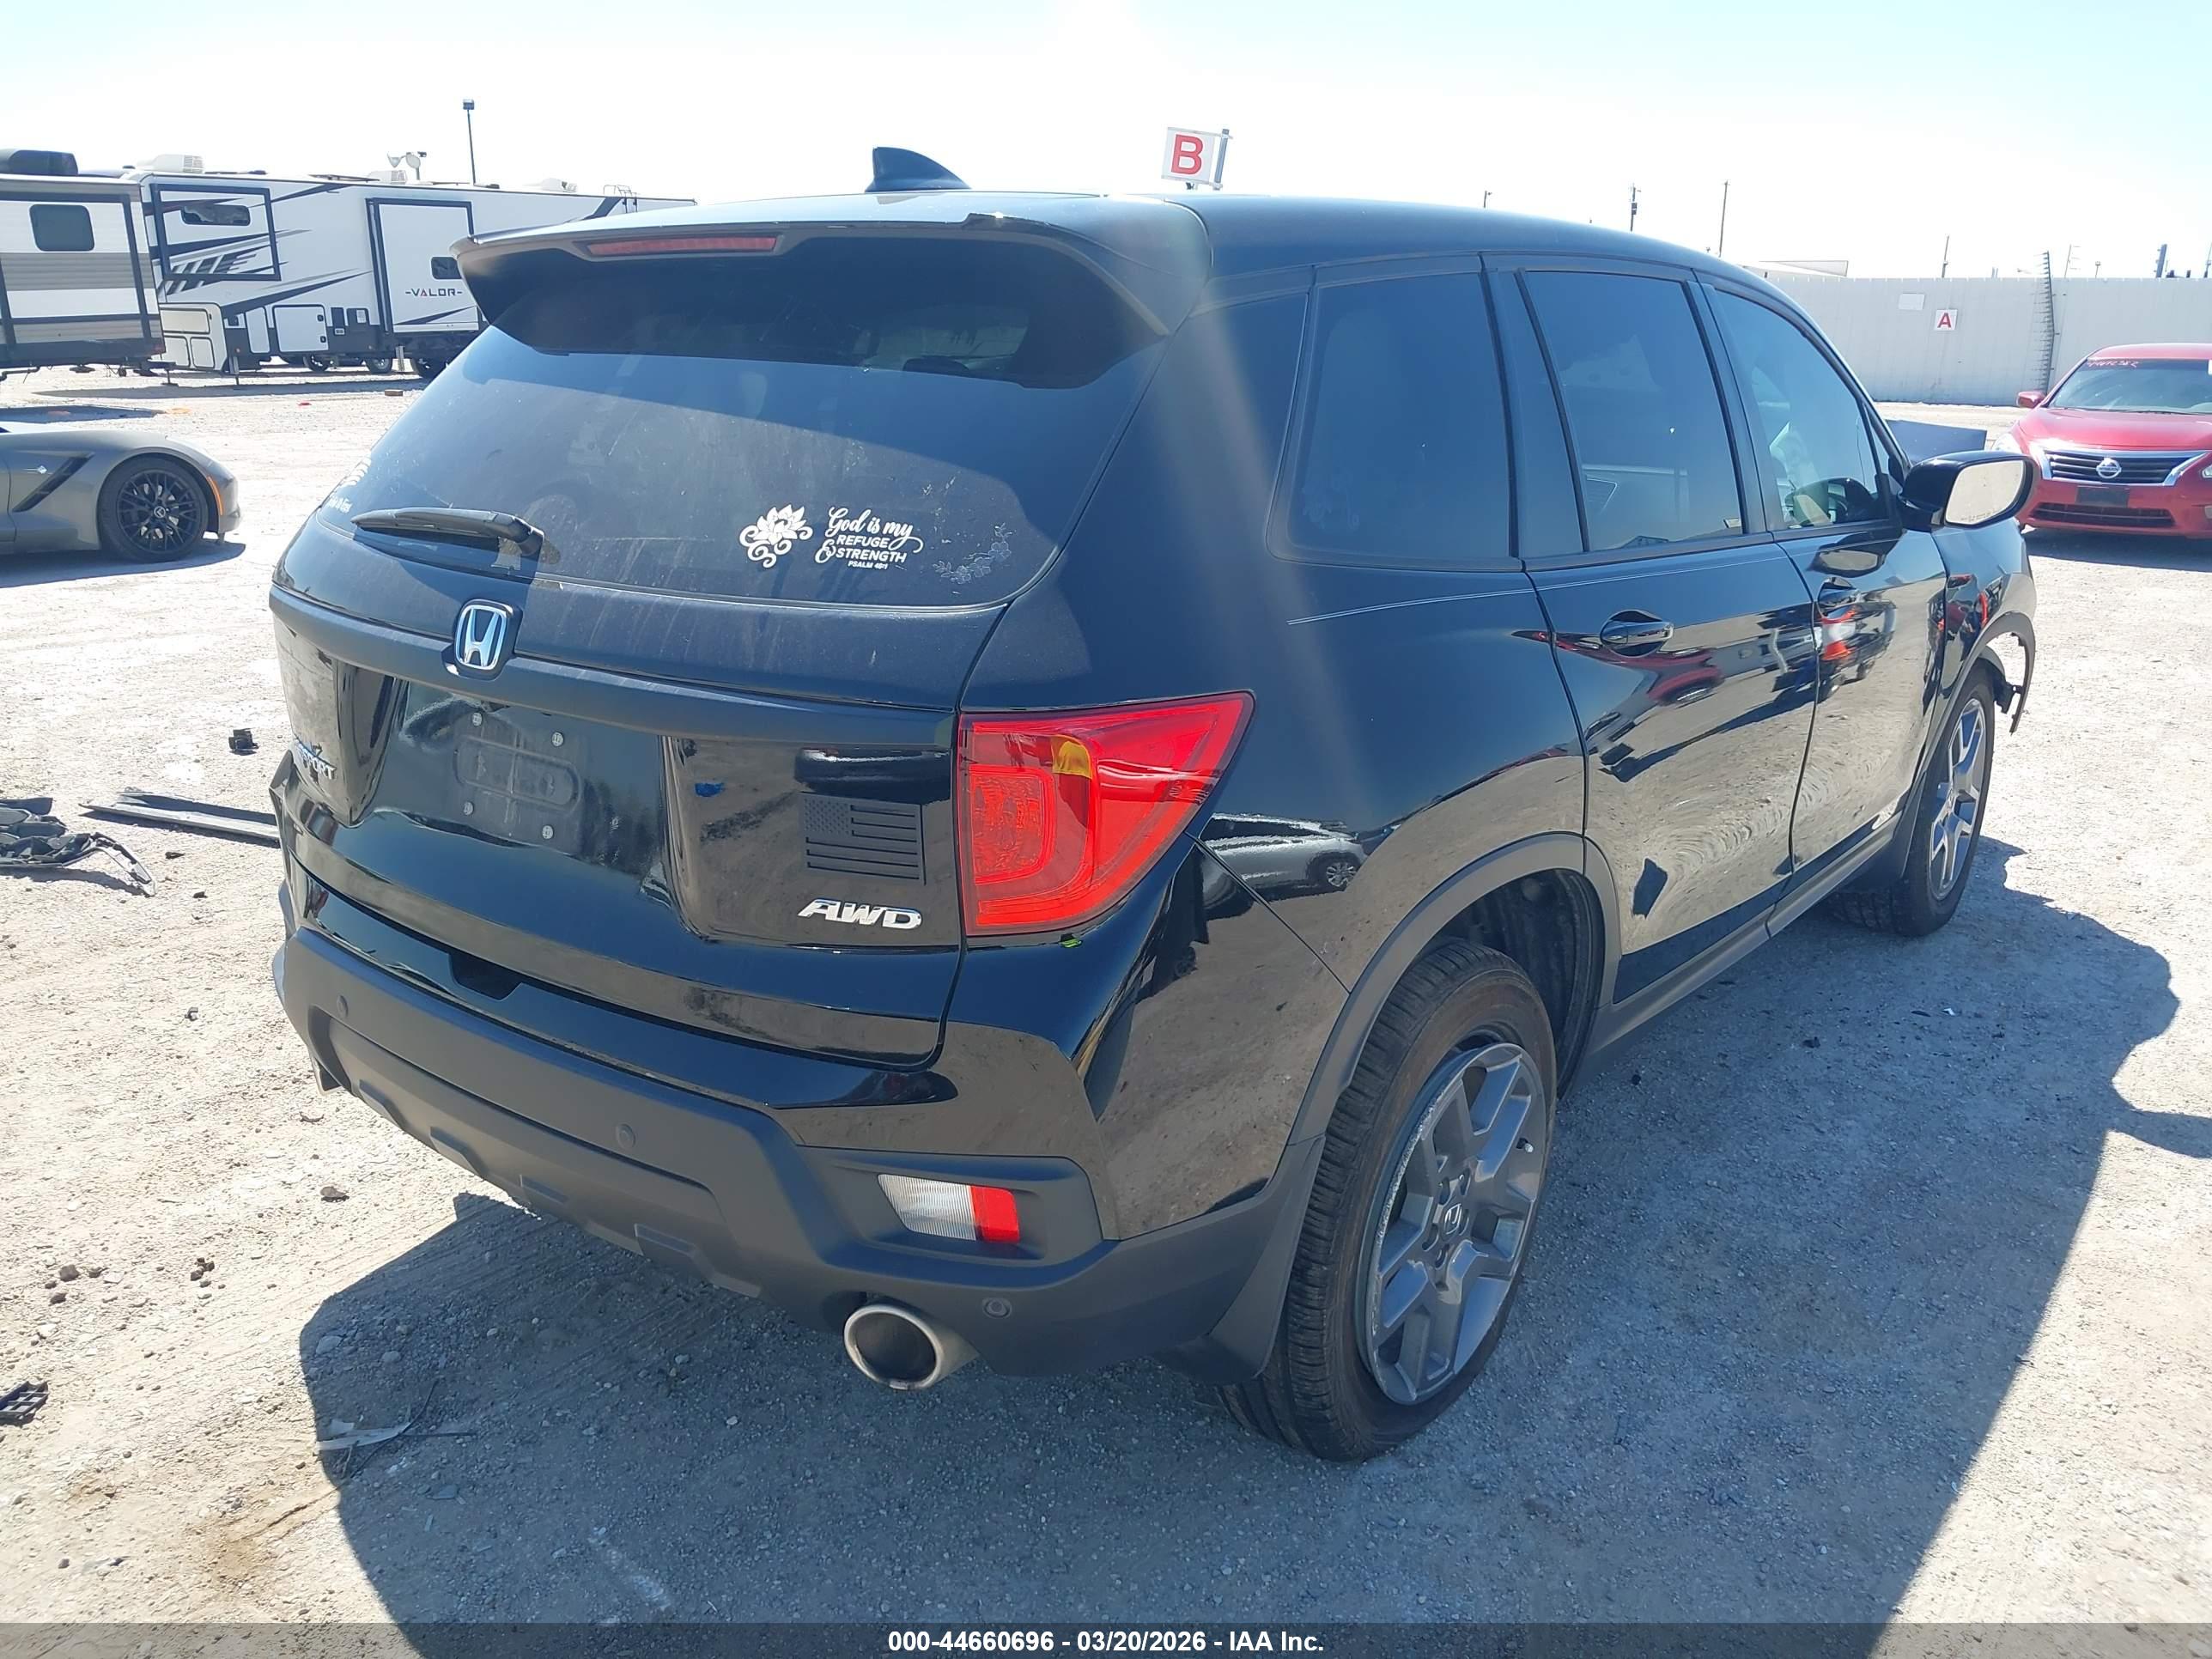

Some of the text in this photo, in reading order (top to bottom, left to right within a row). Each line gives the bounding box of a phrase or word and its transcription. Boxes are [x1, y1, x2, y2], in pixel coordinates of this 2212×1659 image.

[1171, 134, 1204, 175] B
[1936, 312, 1952, 328] A
[825, 507, 924, 553] God is my
[836, 534, 890, 549] REFUGE
[836, 547, 908, 562] STRENGTH
[848, 560, 874, 568] PSALM
[798, 897, 923, 930] AWD
